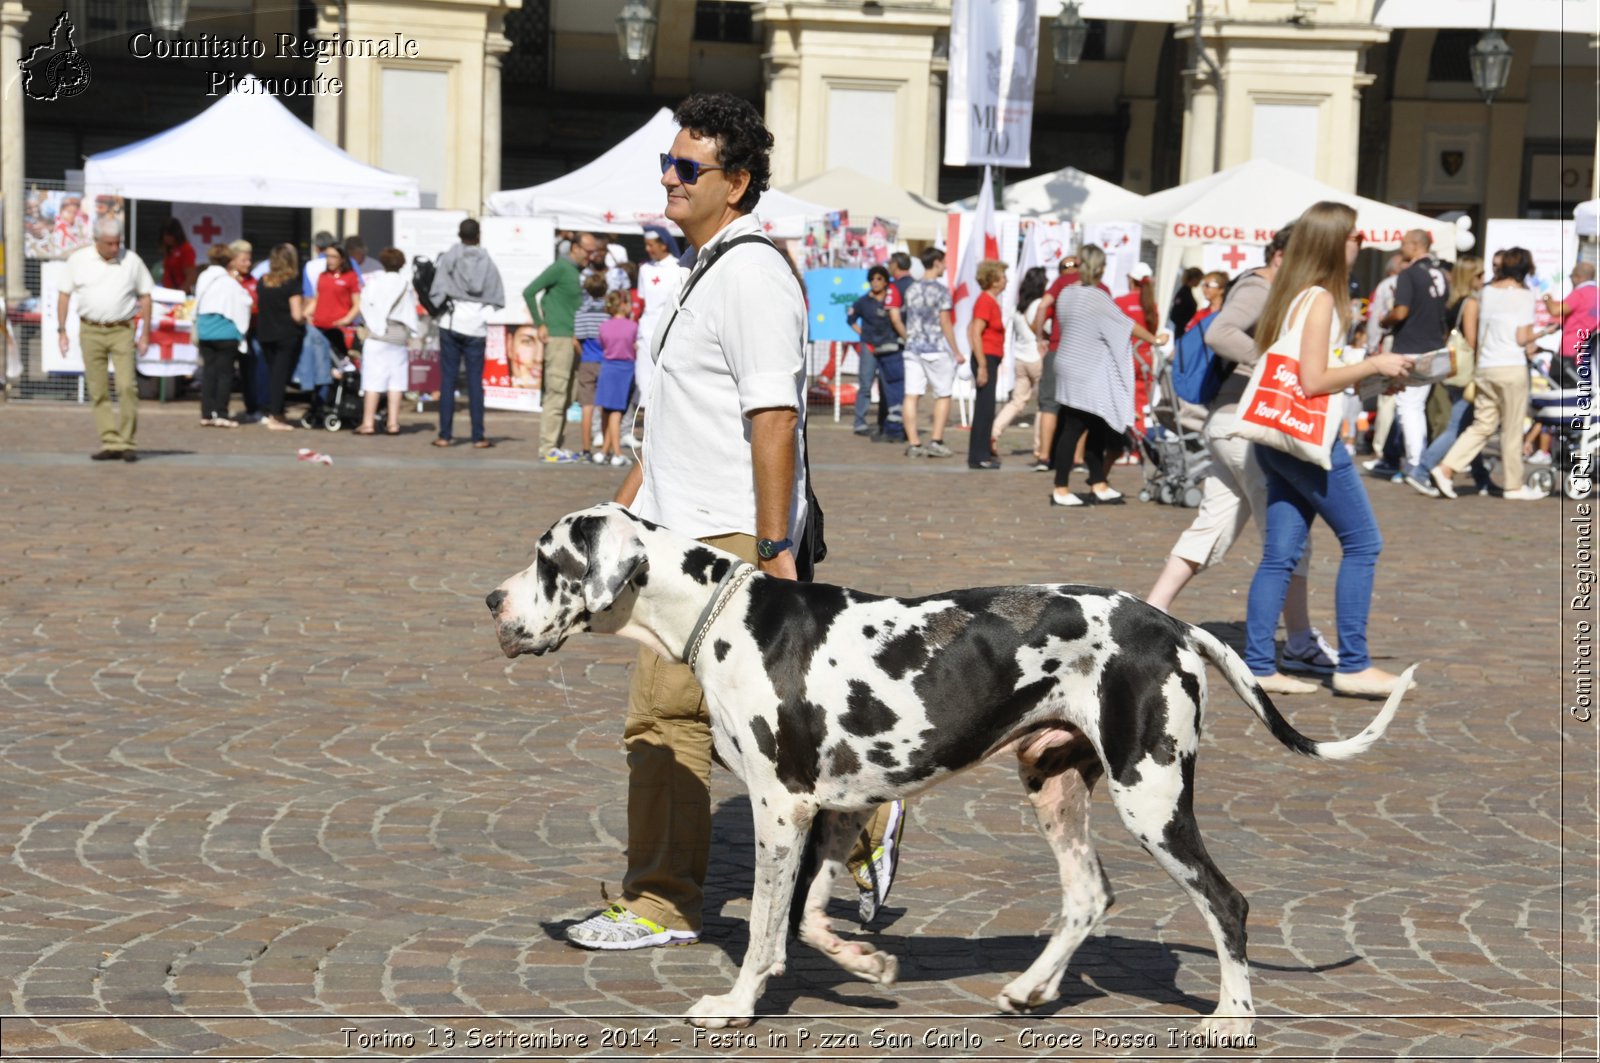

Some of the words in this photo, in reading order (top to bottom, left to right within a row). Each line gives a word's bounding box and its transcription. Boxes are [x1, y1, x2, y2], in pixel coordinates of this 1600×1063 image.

[1173, 223, 1245, 240] CROCE
[1254, 400, 1281, 420] Your
[1280, 409, 1315, 435] Local
